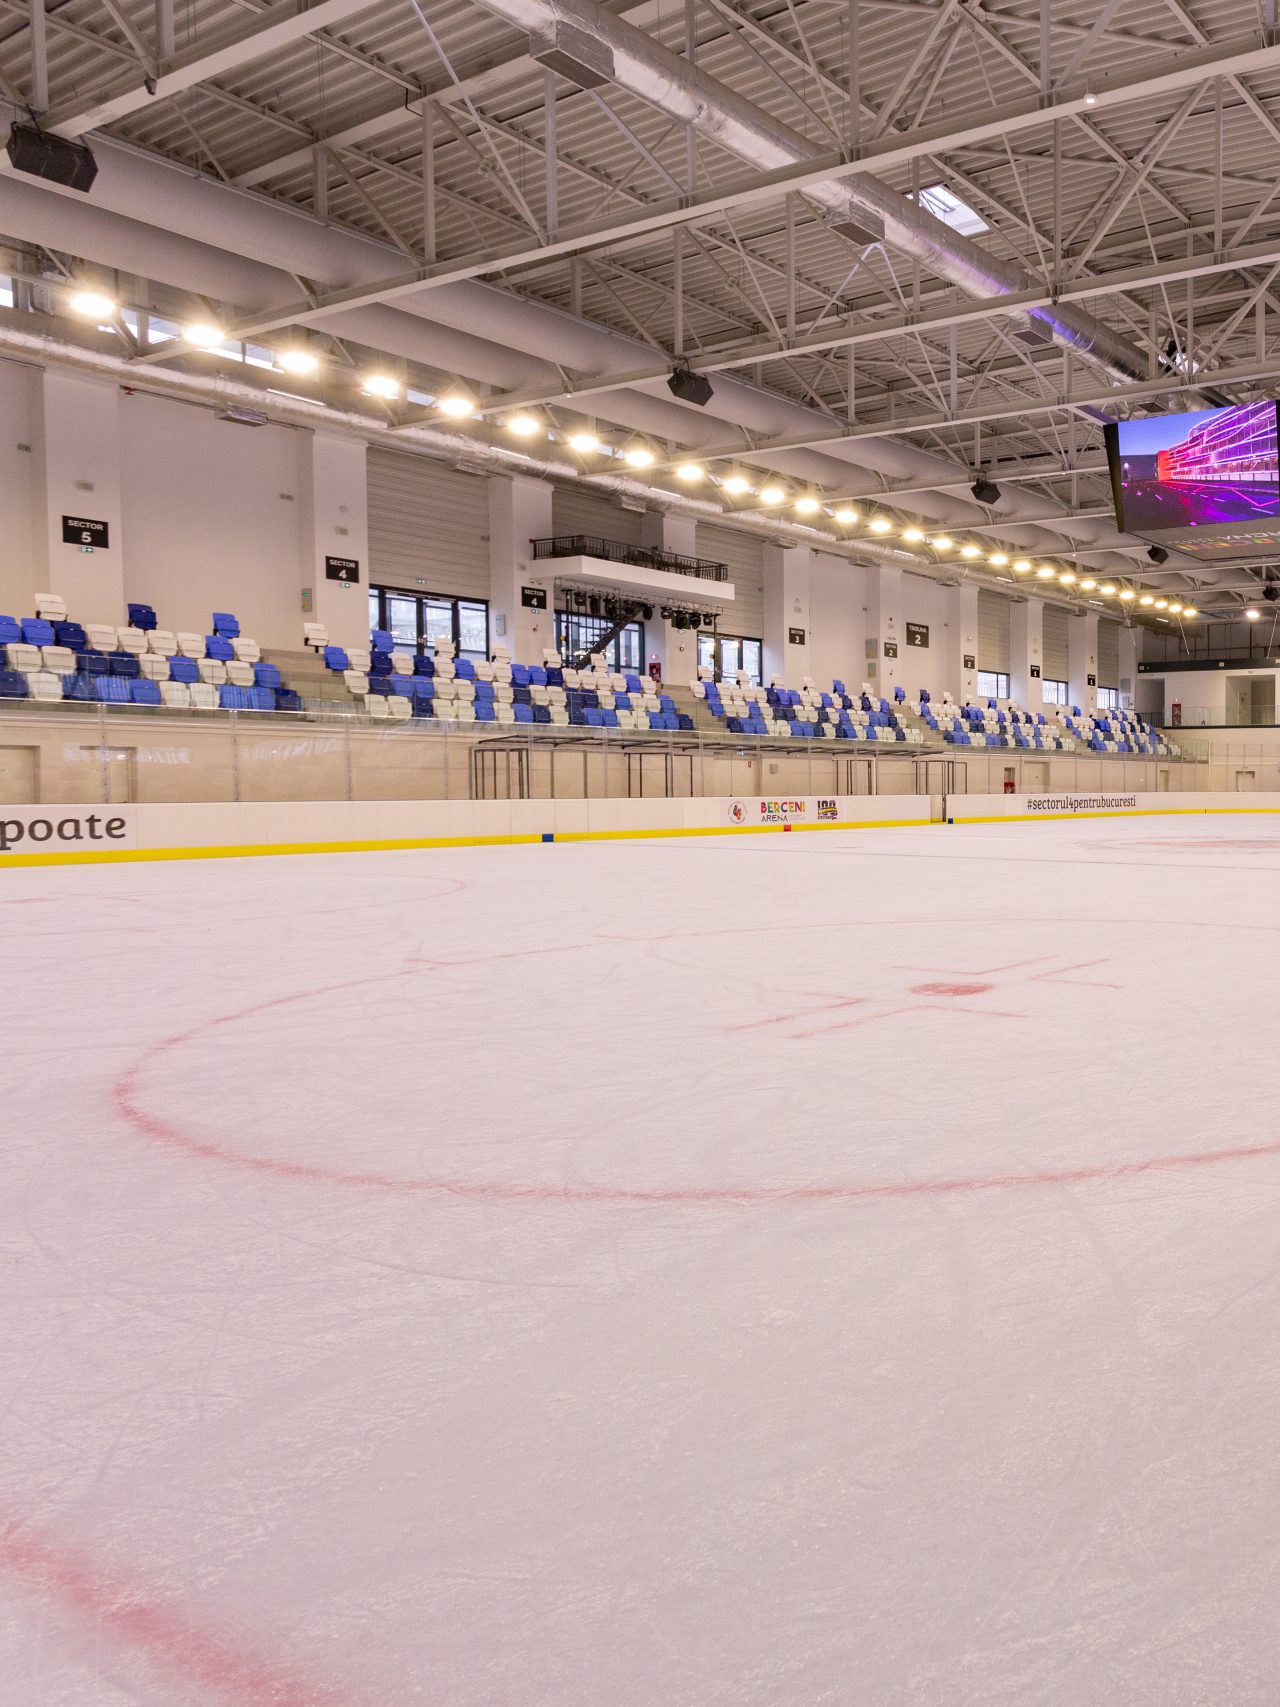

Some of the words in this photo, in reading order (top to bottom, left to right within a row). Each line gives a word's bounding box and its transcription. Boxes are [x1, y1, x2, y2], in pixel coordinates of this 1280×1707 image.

[68, 520, 104, 531] SECTOR
[81, 531, 92, 543] 5
[329, 560, 356, 568] SECTOR
[338, 569, 348, 579] 4
[531, 597, 538, 606] 4
[795, 635, 800, 643] 3
[915, 634, 922, 645] 2
[889, 649, 894, 657] 2
[761, 802, 805, 813] BERCENI
[1027, 795, 1136, 812] #sectorul4pentrubucuresti
[761, 814, 789, 822] ARENA
[0, 814, 126, 851] poate
